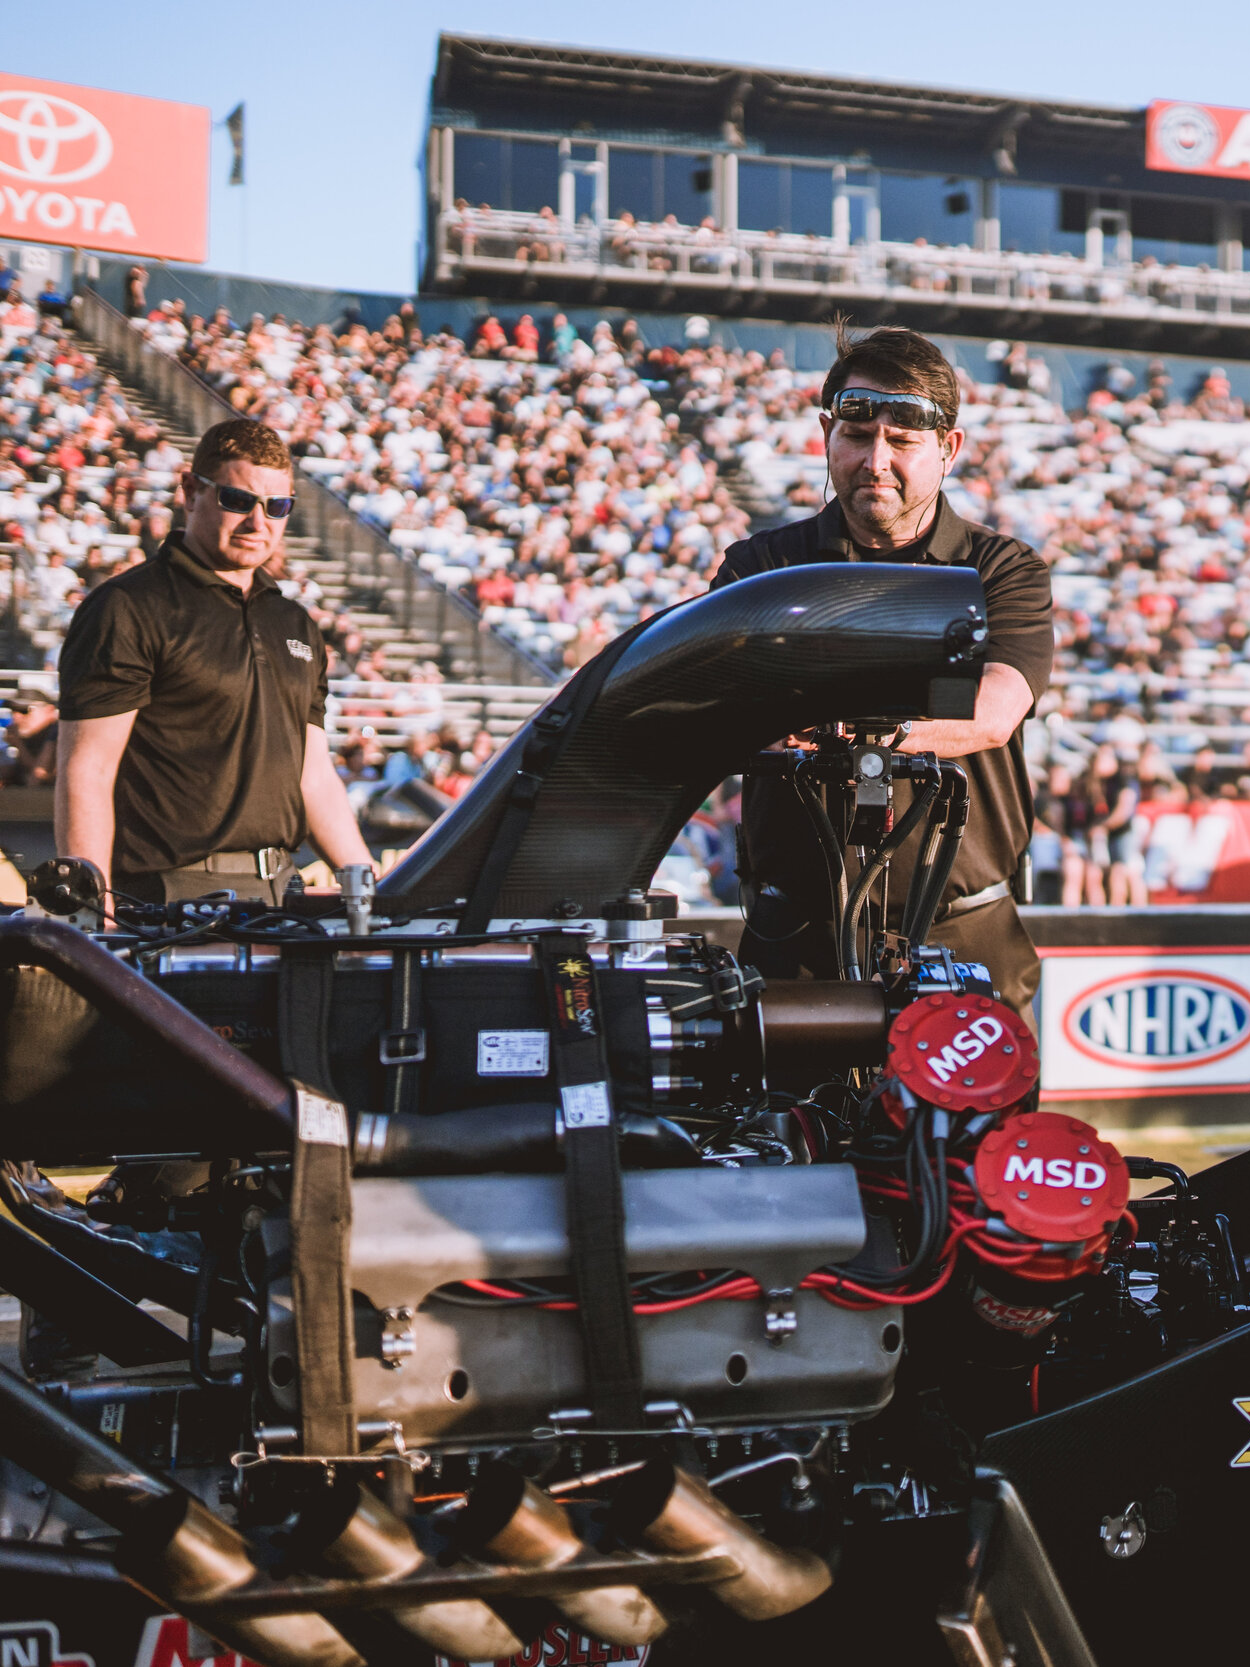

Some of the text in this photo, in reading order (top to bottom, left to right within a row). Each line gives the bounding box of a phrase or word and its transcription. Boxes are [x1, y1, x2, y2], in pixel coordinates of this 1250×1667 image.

[0, 185, 137, 238] YOTA
[1087, 983, 1242, 1056] NHRA
[927, 1015, 1004, 1082] MSD
[1003, 1154, 1107, 1190] MSD
[978, 1296, 1049, 1322] MSD
